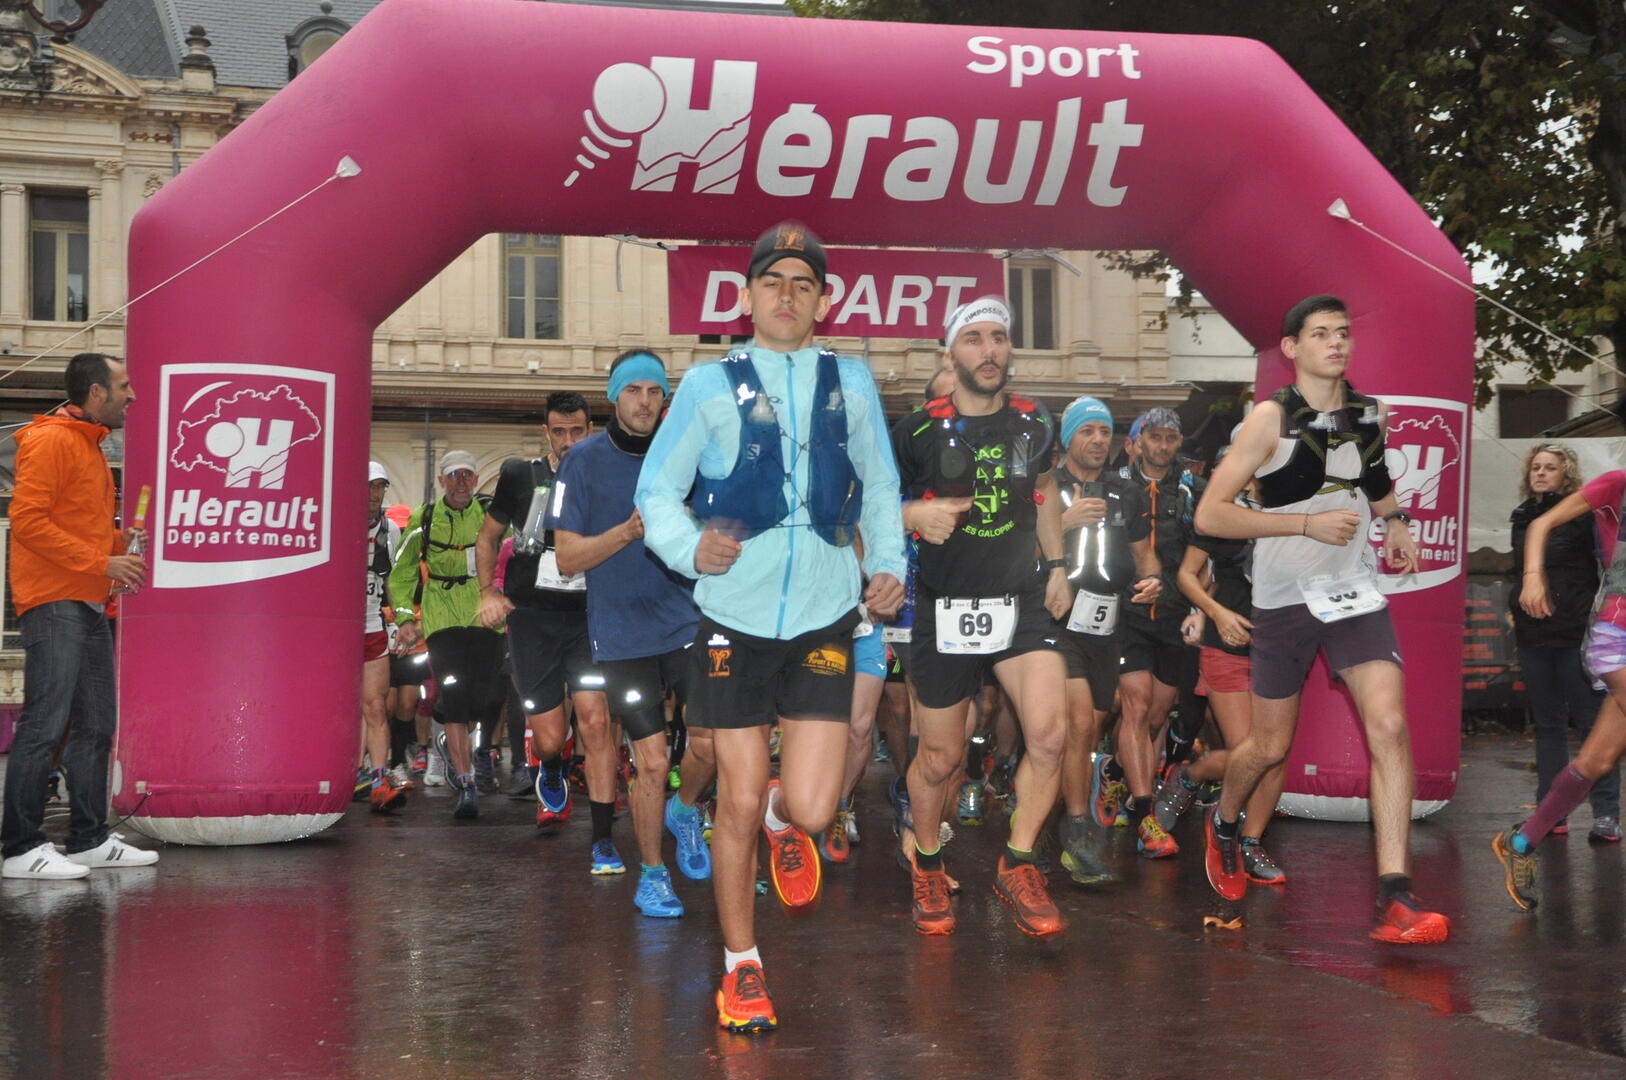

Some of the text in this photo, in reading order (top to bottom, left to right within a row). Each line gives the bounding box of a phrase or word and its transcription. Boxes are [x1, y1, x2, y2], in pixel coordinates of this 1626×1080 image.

[966, 36, 1142, 88] Sport
[631, 56, 1145, 208] Hérault
[700, 270, 977, 328] DPART
[168, 489, 319, 531] Hérault
[167, 528, 317, 548] Département
[959, 613, 993, 637] 69
[1094, 605, 1109, 623] 5
